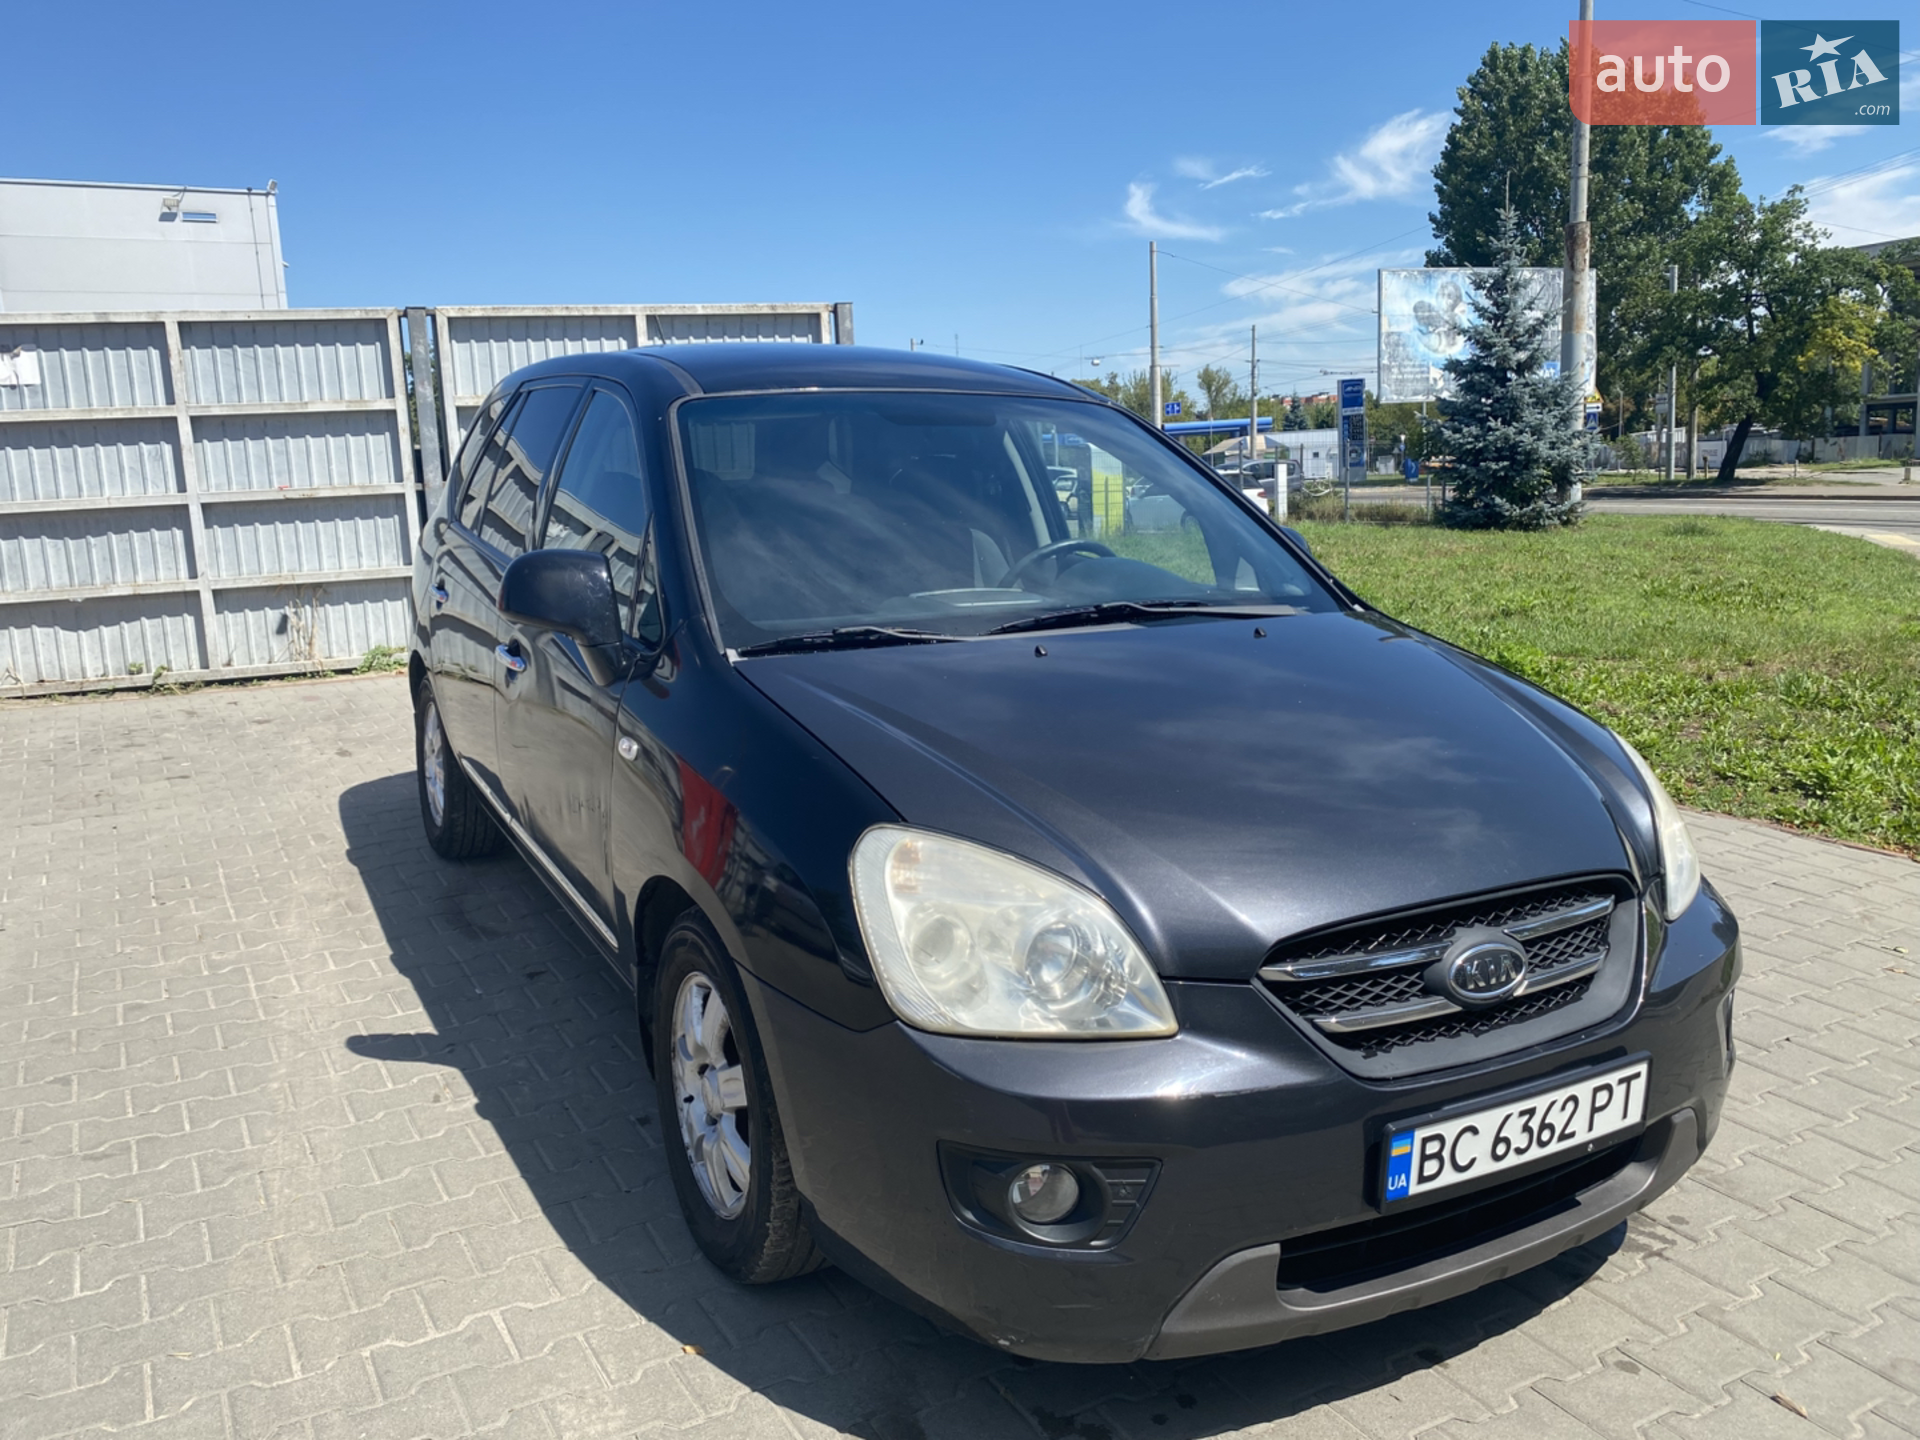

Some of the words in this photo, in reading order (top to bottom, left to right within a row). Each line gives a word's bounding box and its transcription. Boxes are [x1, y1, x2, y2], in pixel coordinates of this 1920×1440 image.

[1462, 954, 1518, 990] KIA
[1416, 1125, 1480, 1185] BC
[1490, 1094, 1580, 1163] 6362
[1586, 1071, 1642, 1133] PT
[1388, 1174, 1408, 1191] UA
